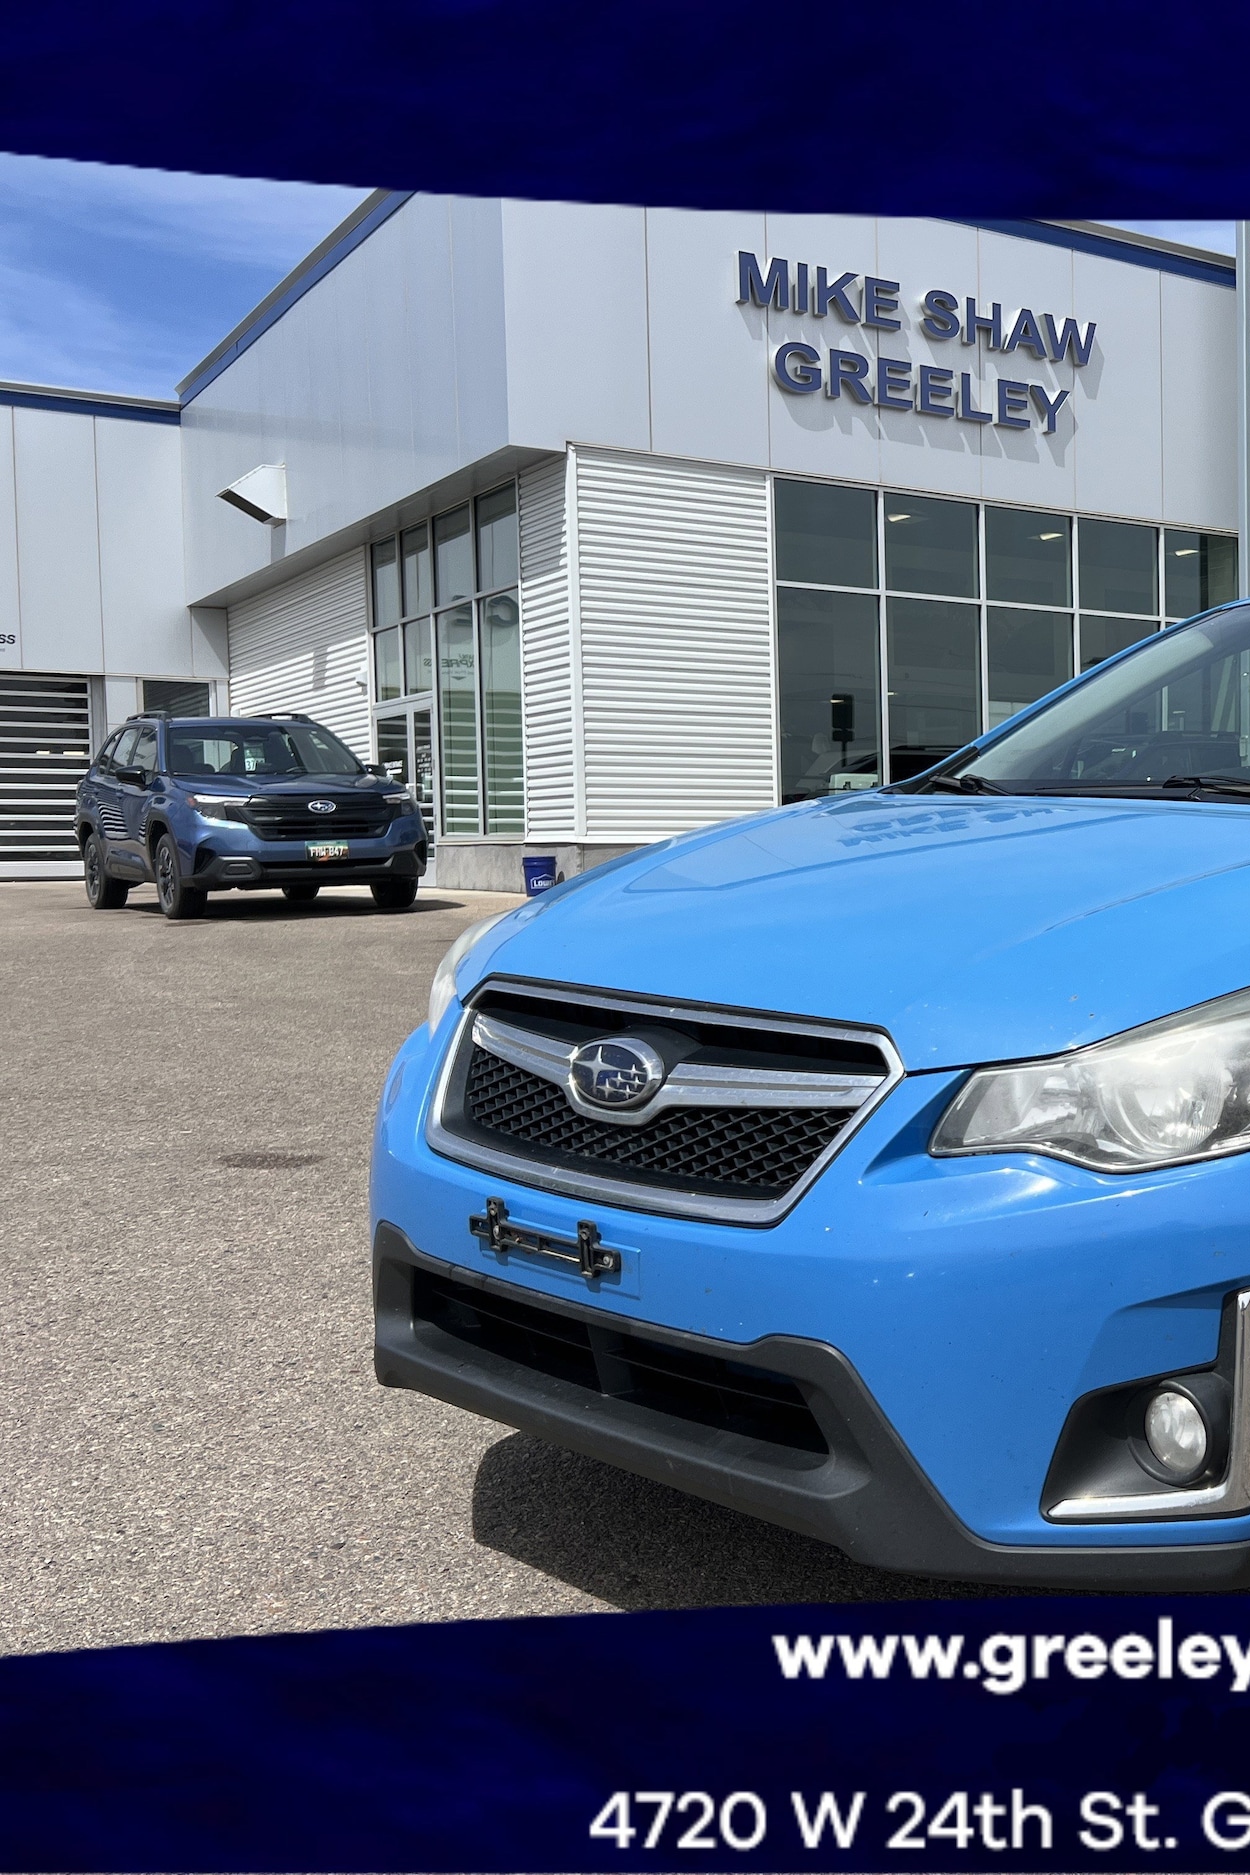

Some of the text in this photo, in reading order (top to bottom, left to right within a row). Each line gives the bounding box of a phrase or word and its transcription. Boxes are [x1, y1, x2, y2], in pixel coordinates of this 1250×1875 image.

[736, 250, 1097, 367] MIKE SHAW
[772, 341, 1070, 433] GREELEY
